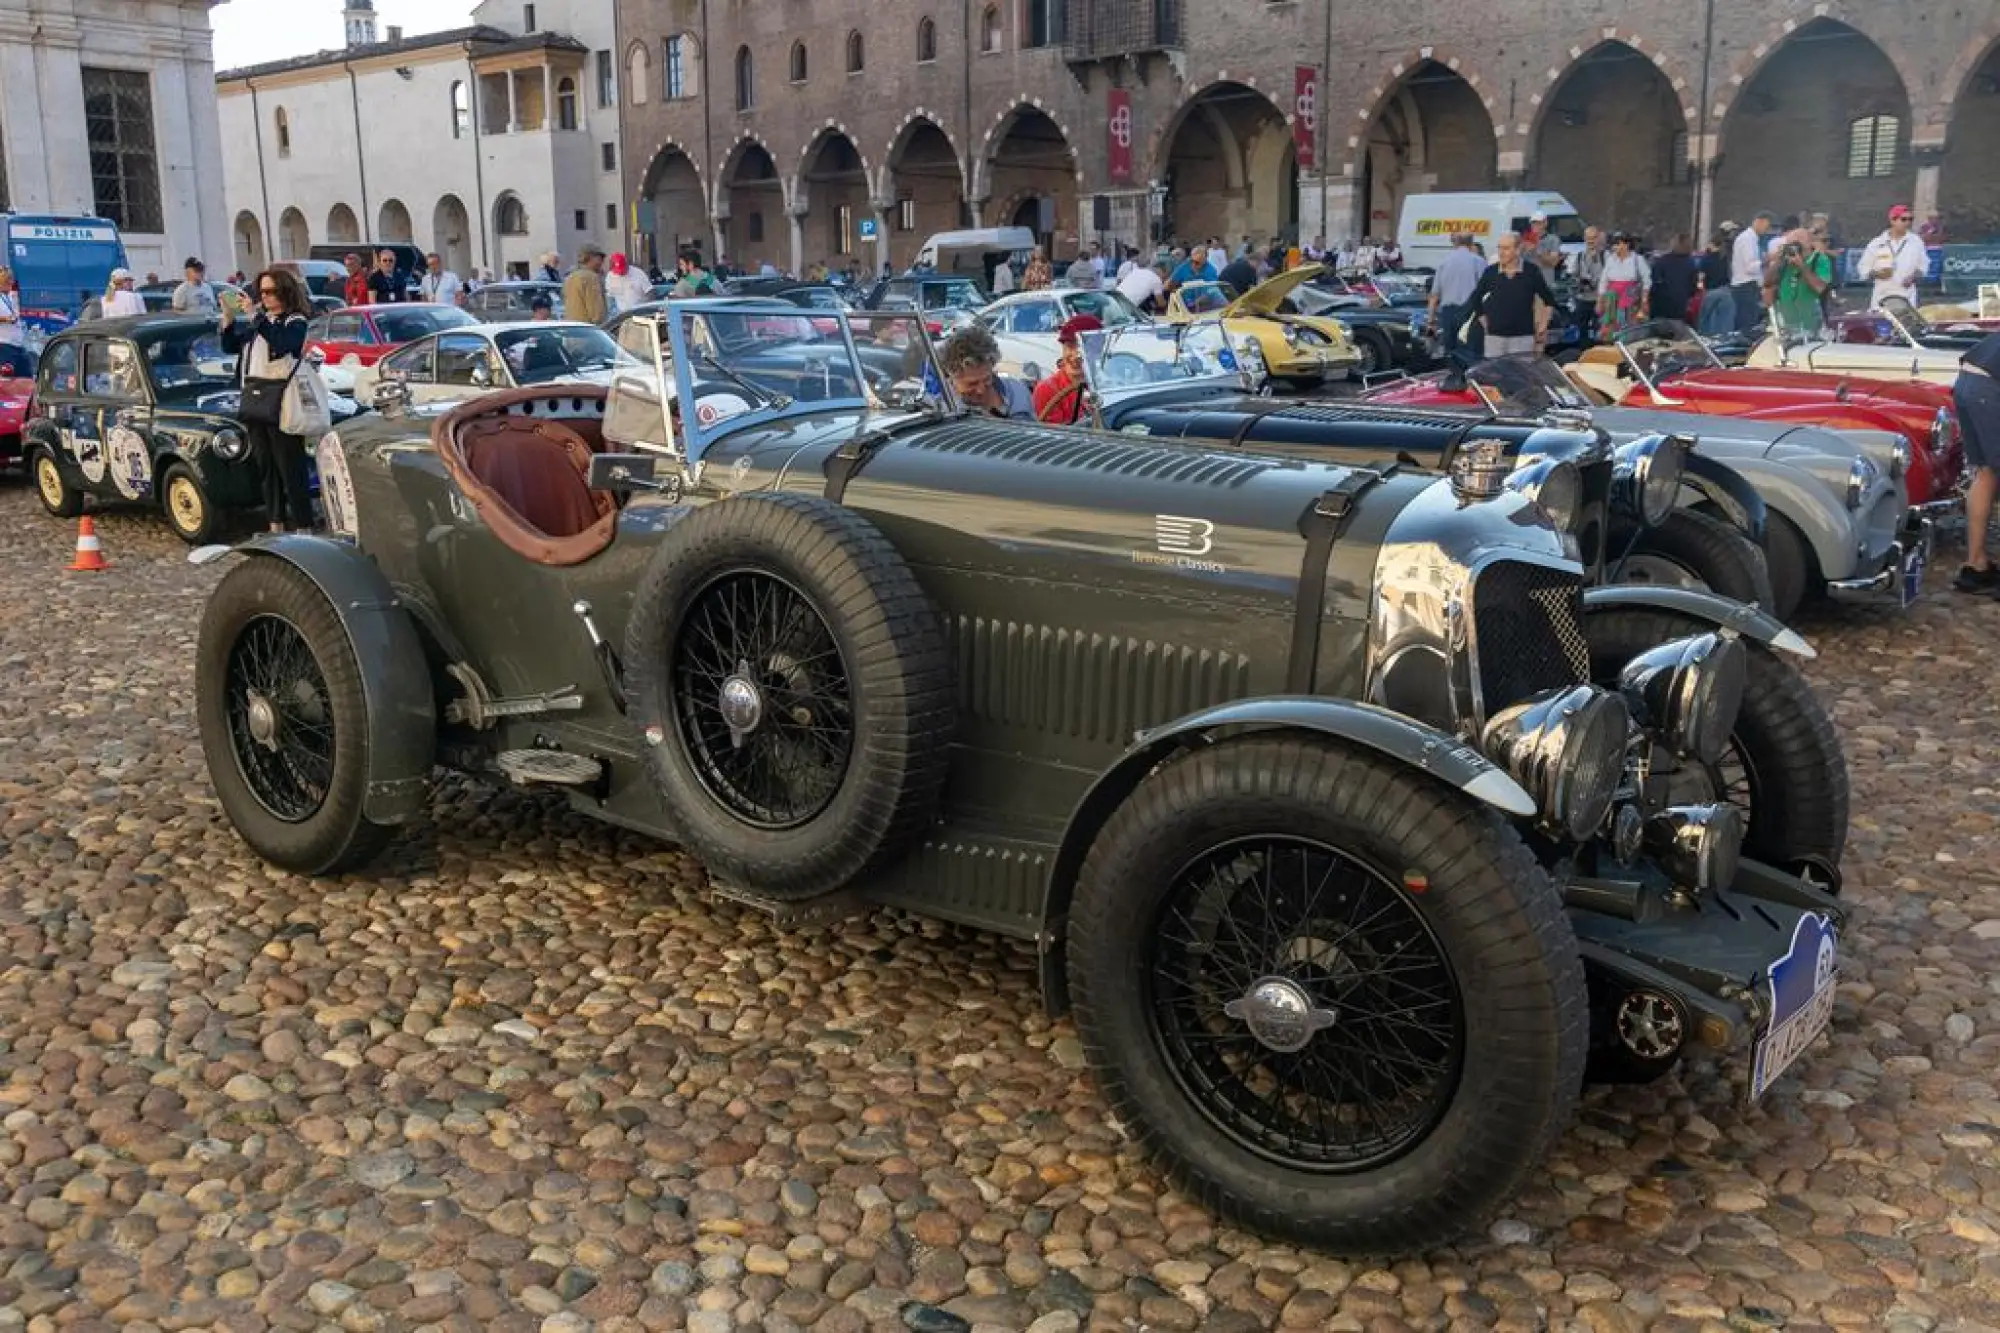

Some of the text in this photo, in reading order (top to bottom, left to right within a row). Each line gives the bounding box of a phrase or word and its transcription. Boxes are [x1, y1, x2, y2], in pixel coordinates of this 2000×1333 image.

[34, 227, 94, 238] POLIZIA
[862, 221, 874, 233] P
[1177, 555, 1226, 574] Classics
